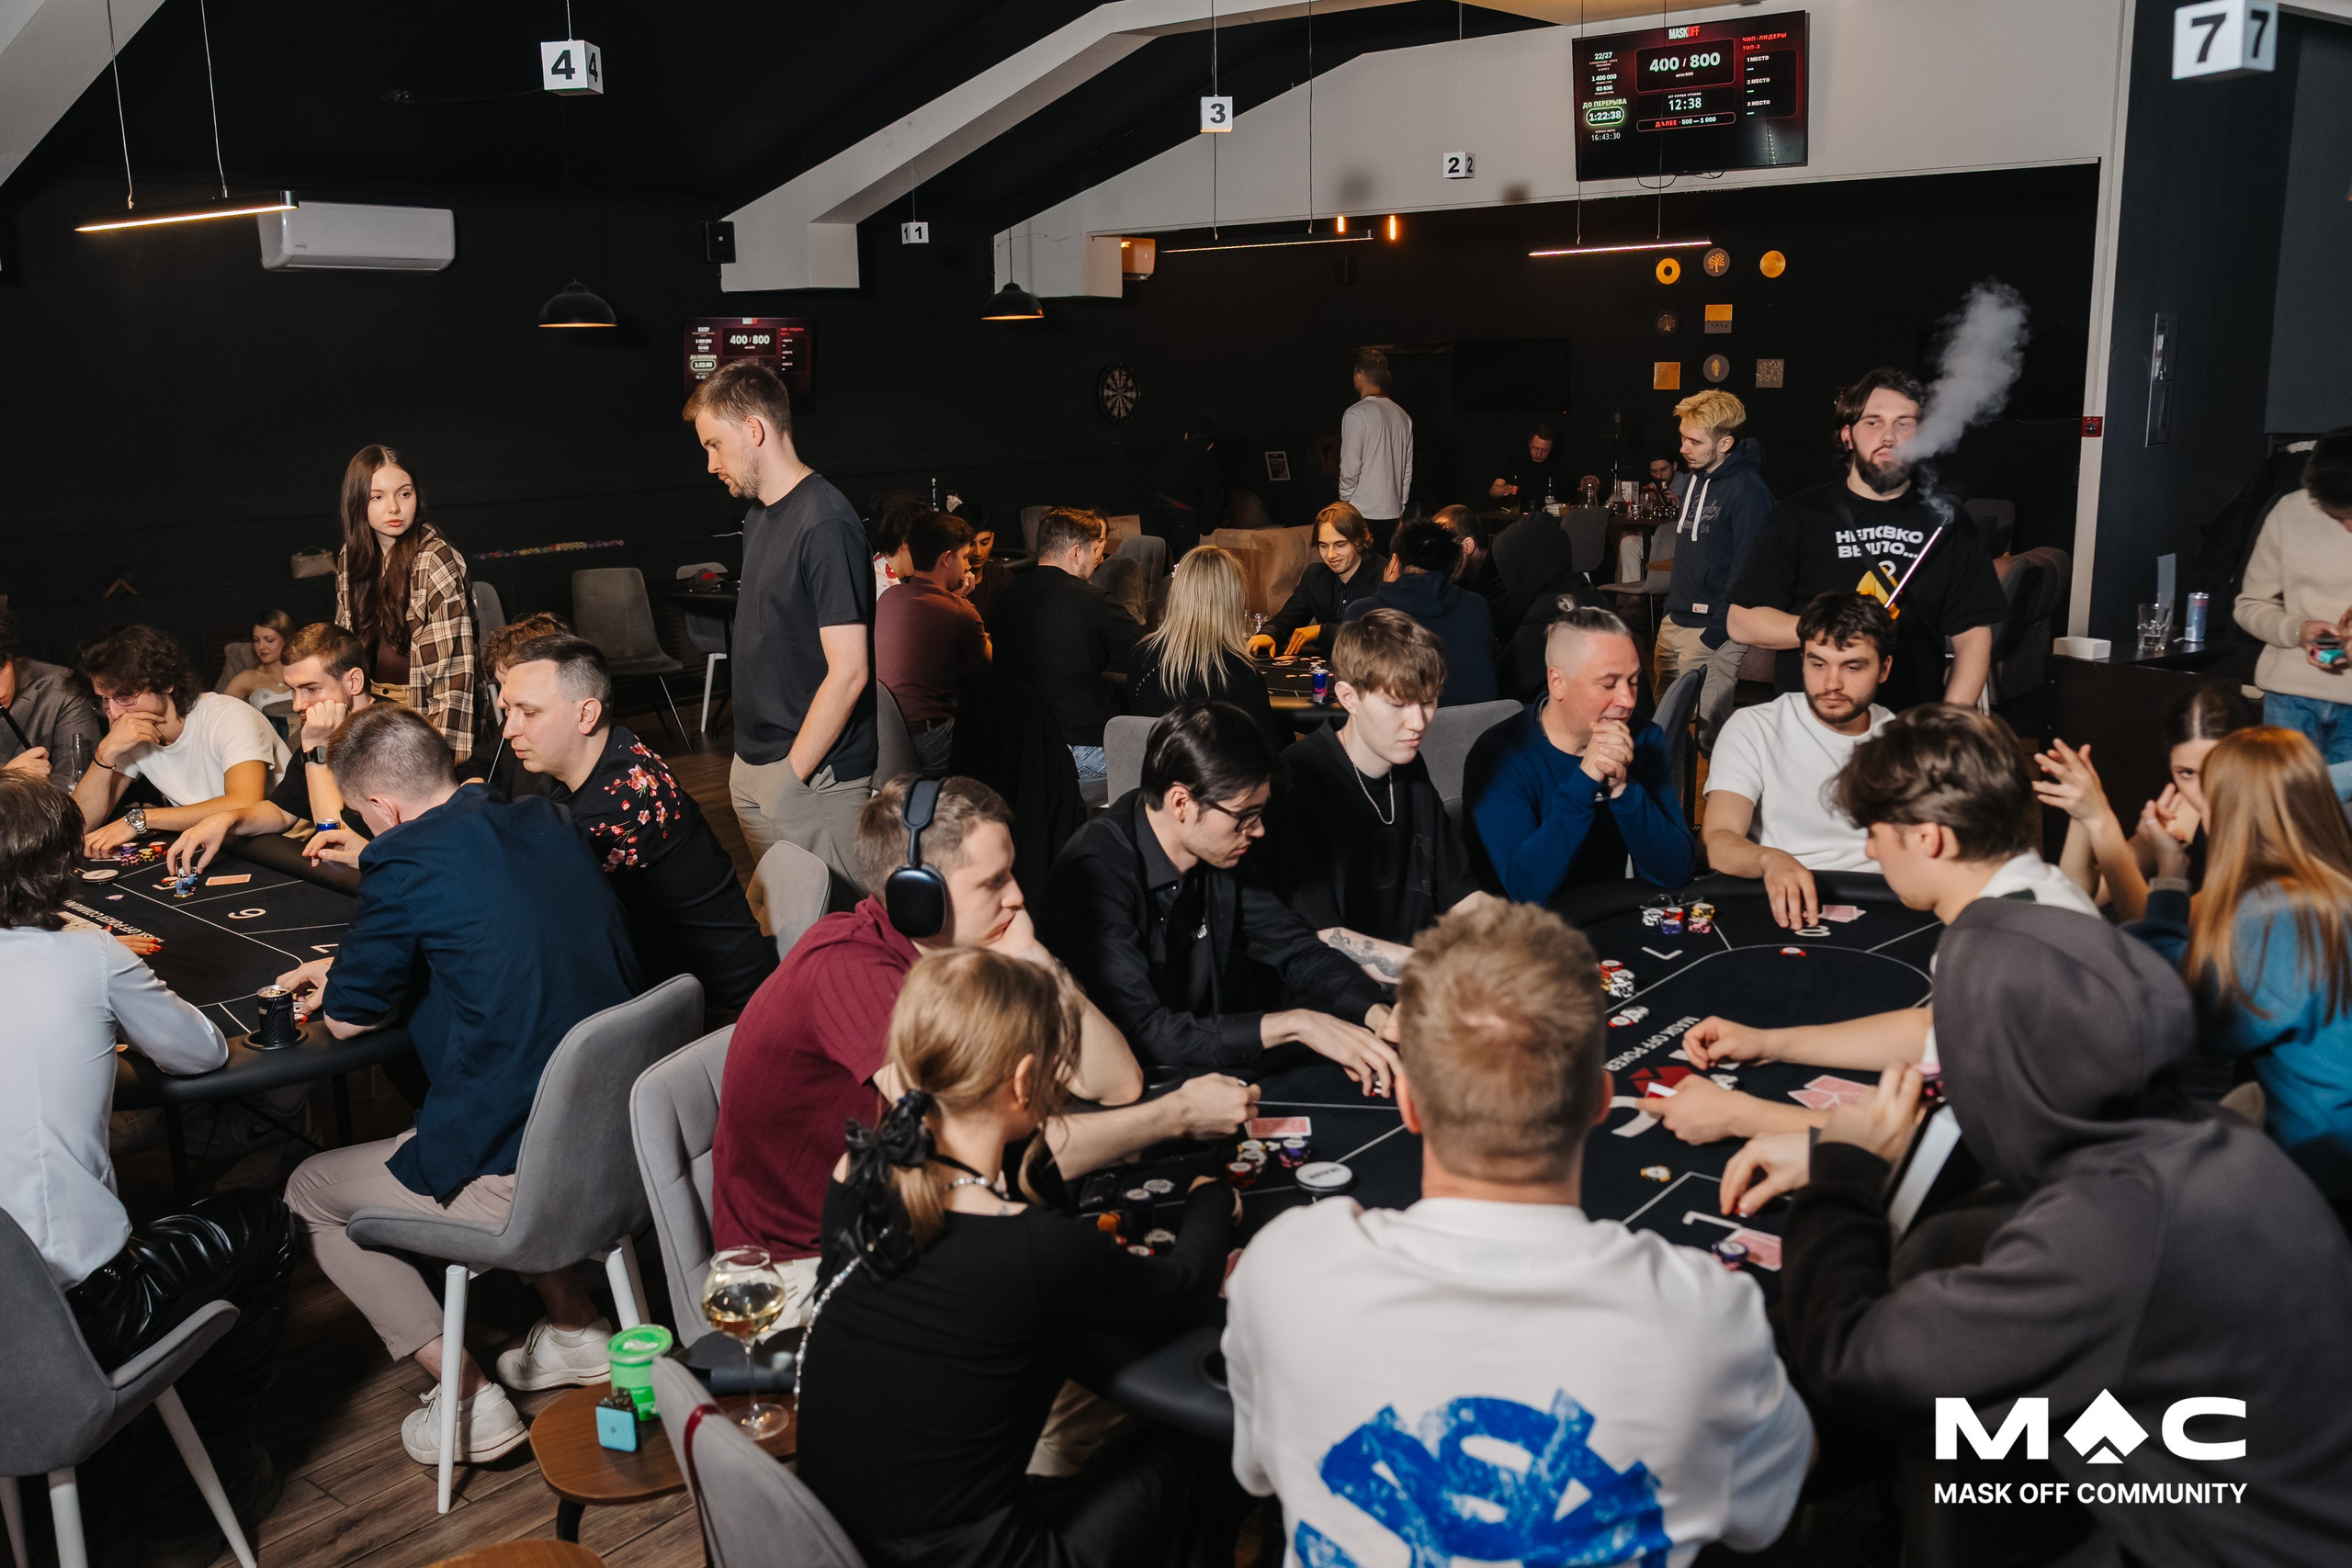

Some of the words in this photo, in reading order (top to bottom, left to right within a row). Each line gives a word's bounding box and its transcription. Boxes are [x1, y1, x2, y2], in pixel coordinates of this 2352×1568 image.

[1668, 26, 1700, 39] MASKOFF
[1742, 33, 1787, 42] ЧИП-ЛИДЕРЫ
[2191, 12, 2227, 63] 7
[2251, 9, 2269, 58] 7
[1594, 51, 1612, 60] 22/27
[1649, 56, 1679, 72] 400
[1690, 52, 1720, 68] 800
[551, 49, 576, 80] 4
[588, 52, 598, 83] 4
[1594, 98, 1627, 107] ПЕРЕРЫВА
[1669, 97, 1702, 111] 12:38
[1210, 103, 1226, 124] 3
[1589, 111, 1622, 121] 1:22:38
[1655, 120, 1677, 128] ДАЛЕЕ
[1591, 132, 1620, 141] 16:43:30
[1448, 157, 1459, 173] 2
[1467, 157, 1473, 173] 2
[904, 227, 908, 240] 1
[915, 226, 922, 239] 1
[730, 335, 748, 344] 400
[752, 335, 770, 344] 800
